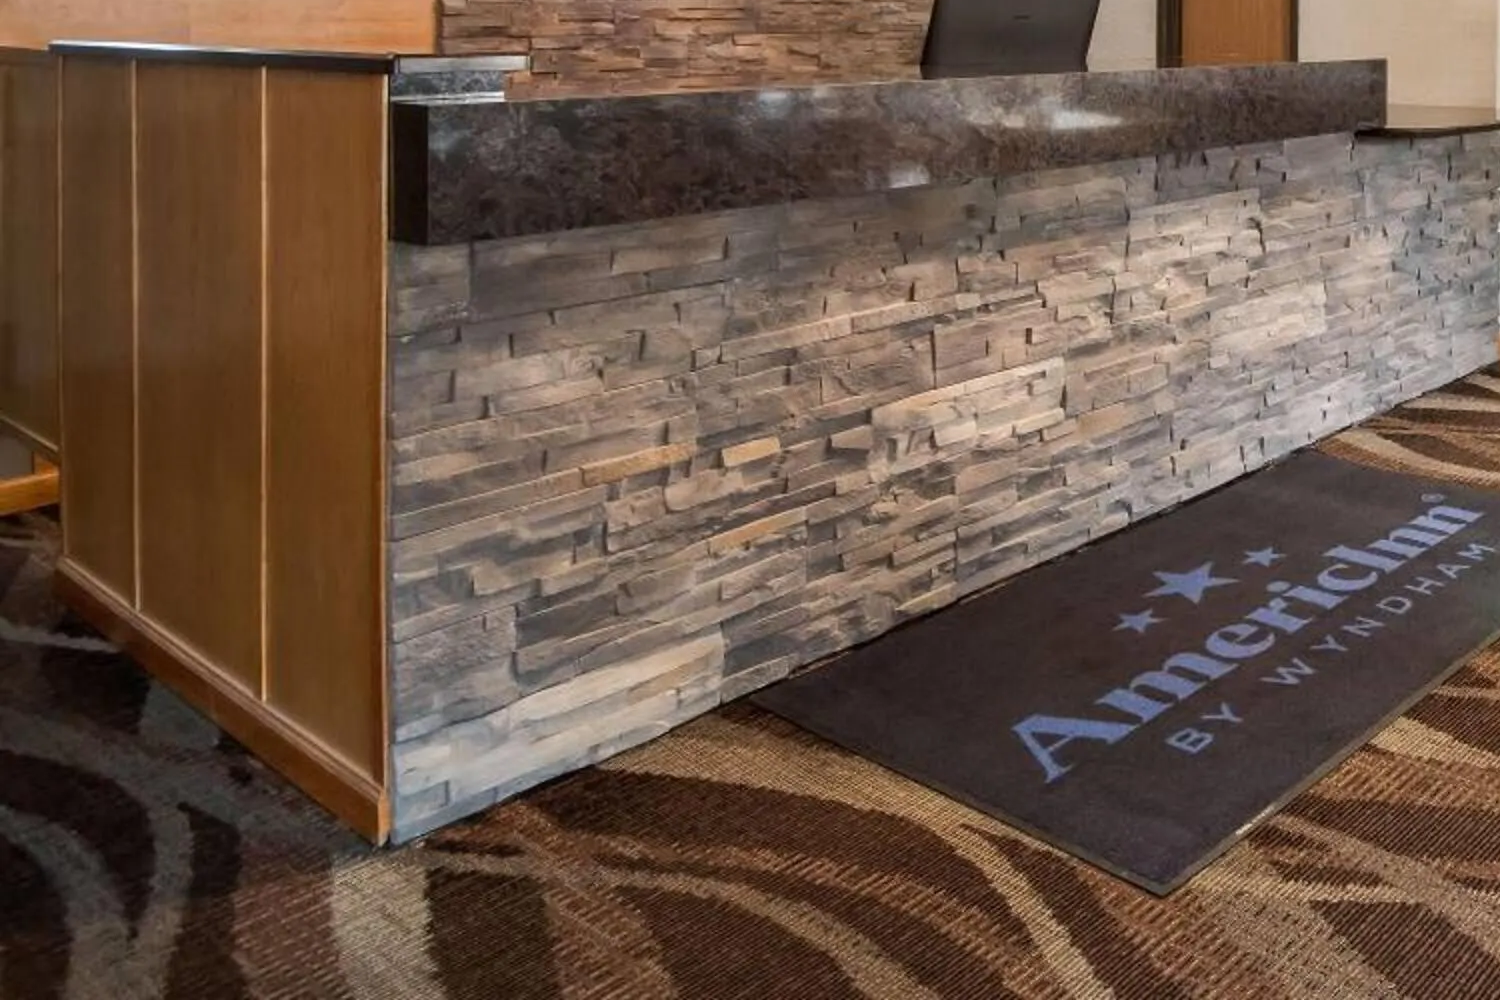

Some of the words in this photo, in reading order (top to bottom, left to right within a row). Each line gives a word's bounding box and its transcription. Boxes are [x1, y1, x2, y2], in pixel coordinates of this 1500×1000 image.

[1012, 505, 1485, 784] AmericInn
[1166, 702, 1243, 753] BY
[1260, 541, 1496, 687] WYNDHAM
